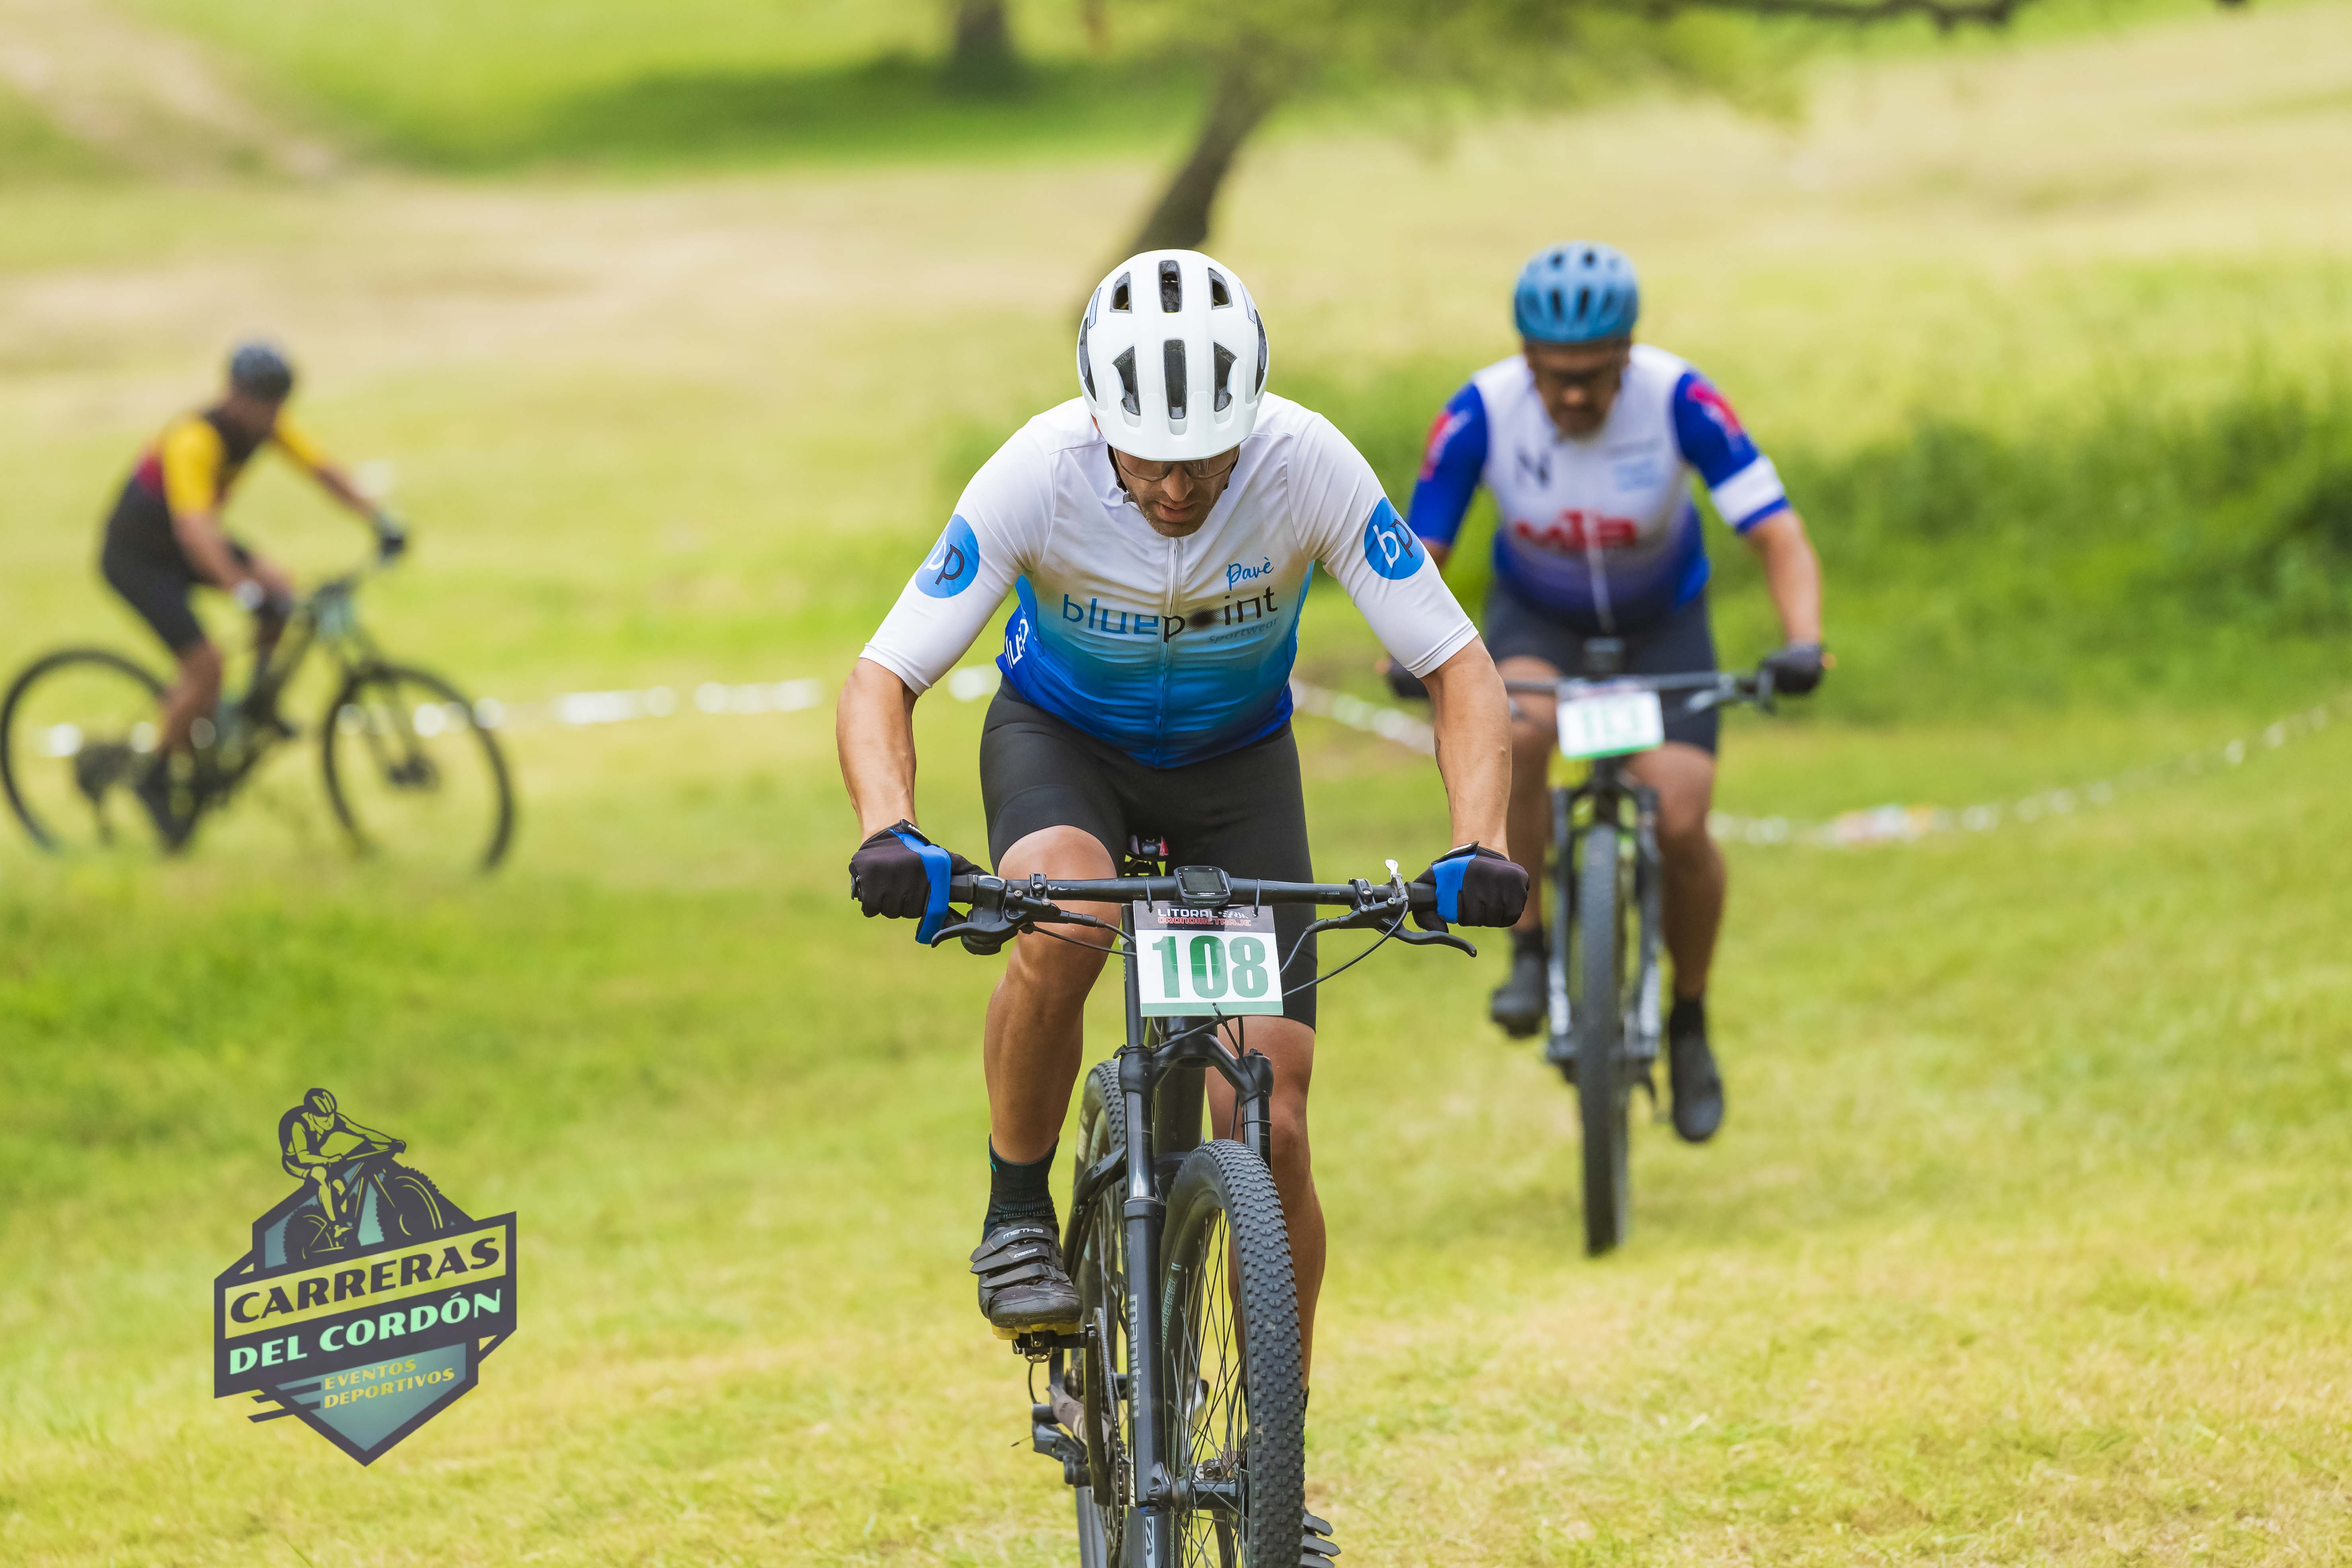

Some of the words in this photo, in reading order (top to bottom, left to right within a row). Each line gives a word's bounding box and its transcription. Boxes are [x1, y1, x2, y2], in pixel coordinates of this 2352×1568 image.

[1372, 519, 1413, 568] bp
[1226, 557, 1274, 591] Pavè
[1207, 618, 1278, 644] sportwear
[1158, 908, 1218, 918] LITORAL
[1158, 916, 1252, 926] CRONOMETRAJE
[1152, 935, 1268, 998] 108
[1014, 1248, 1038, 1258] CROSS
